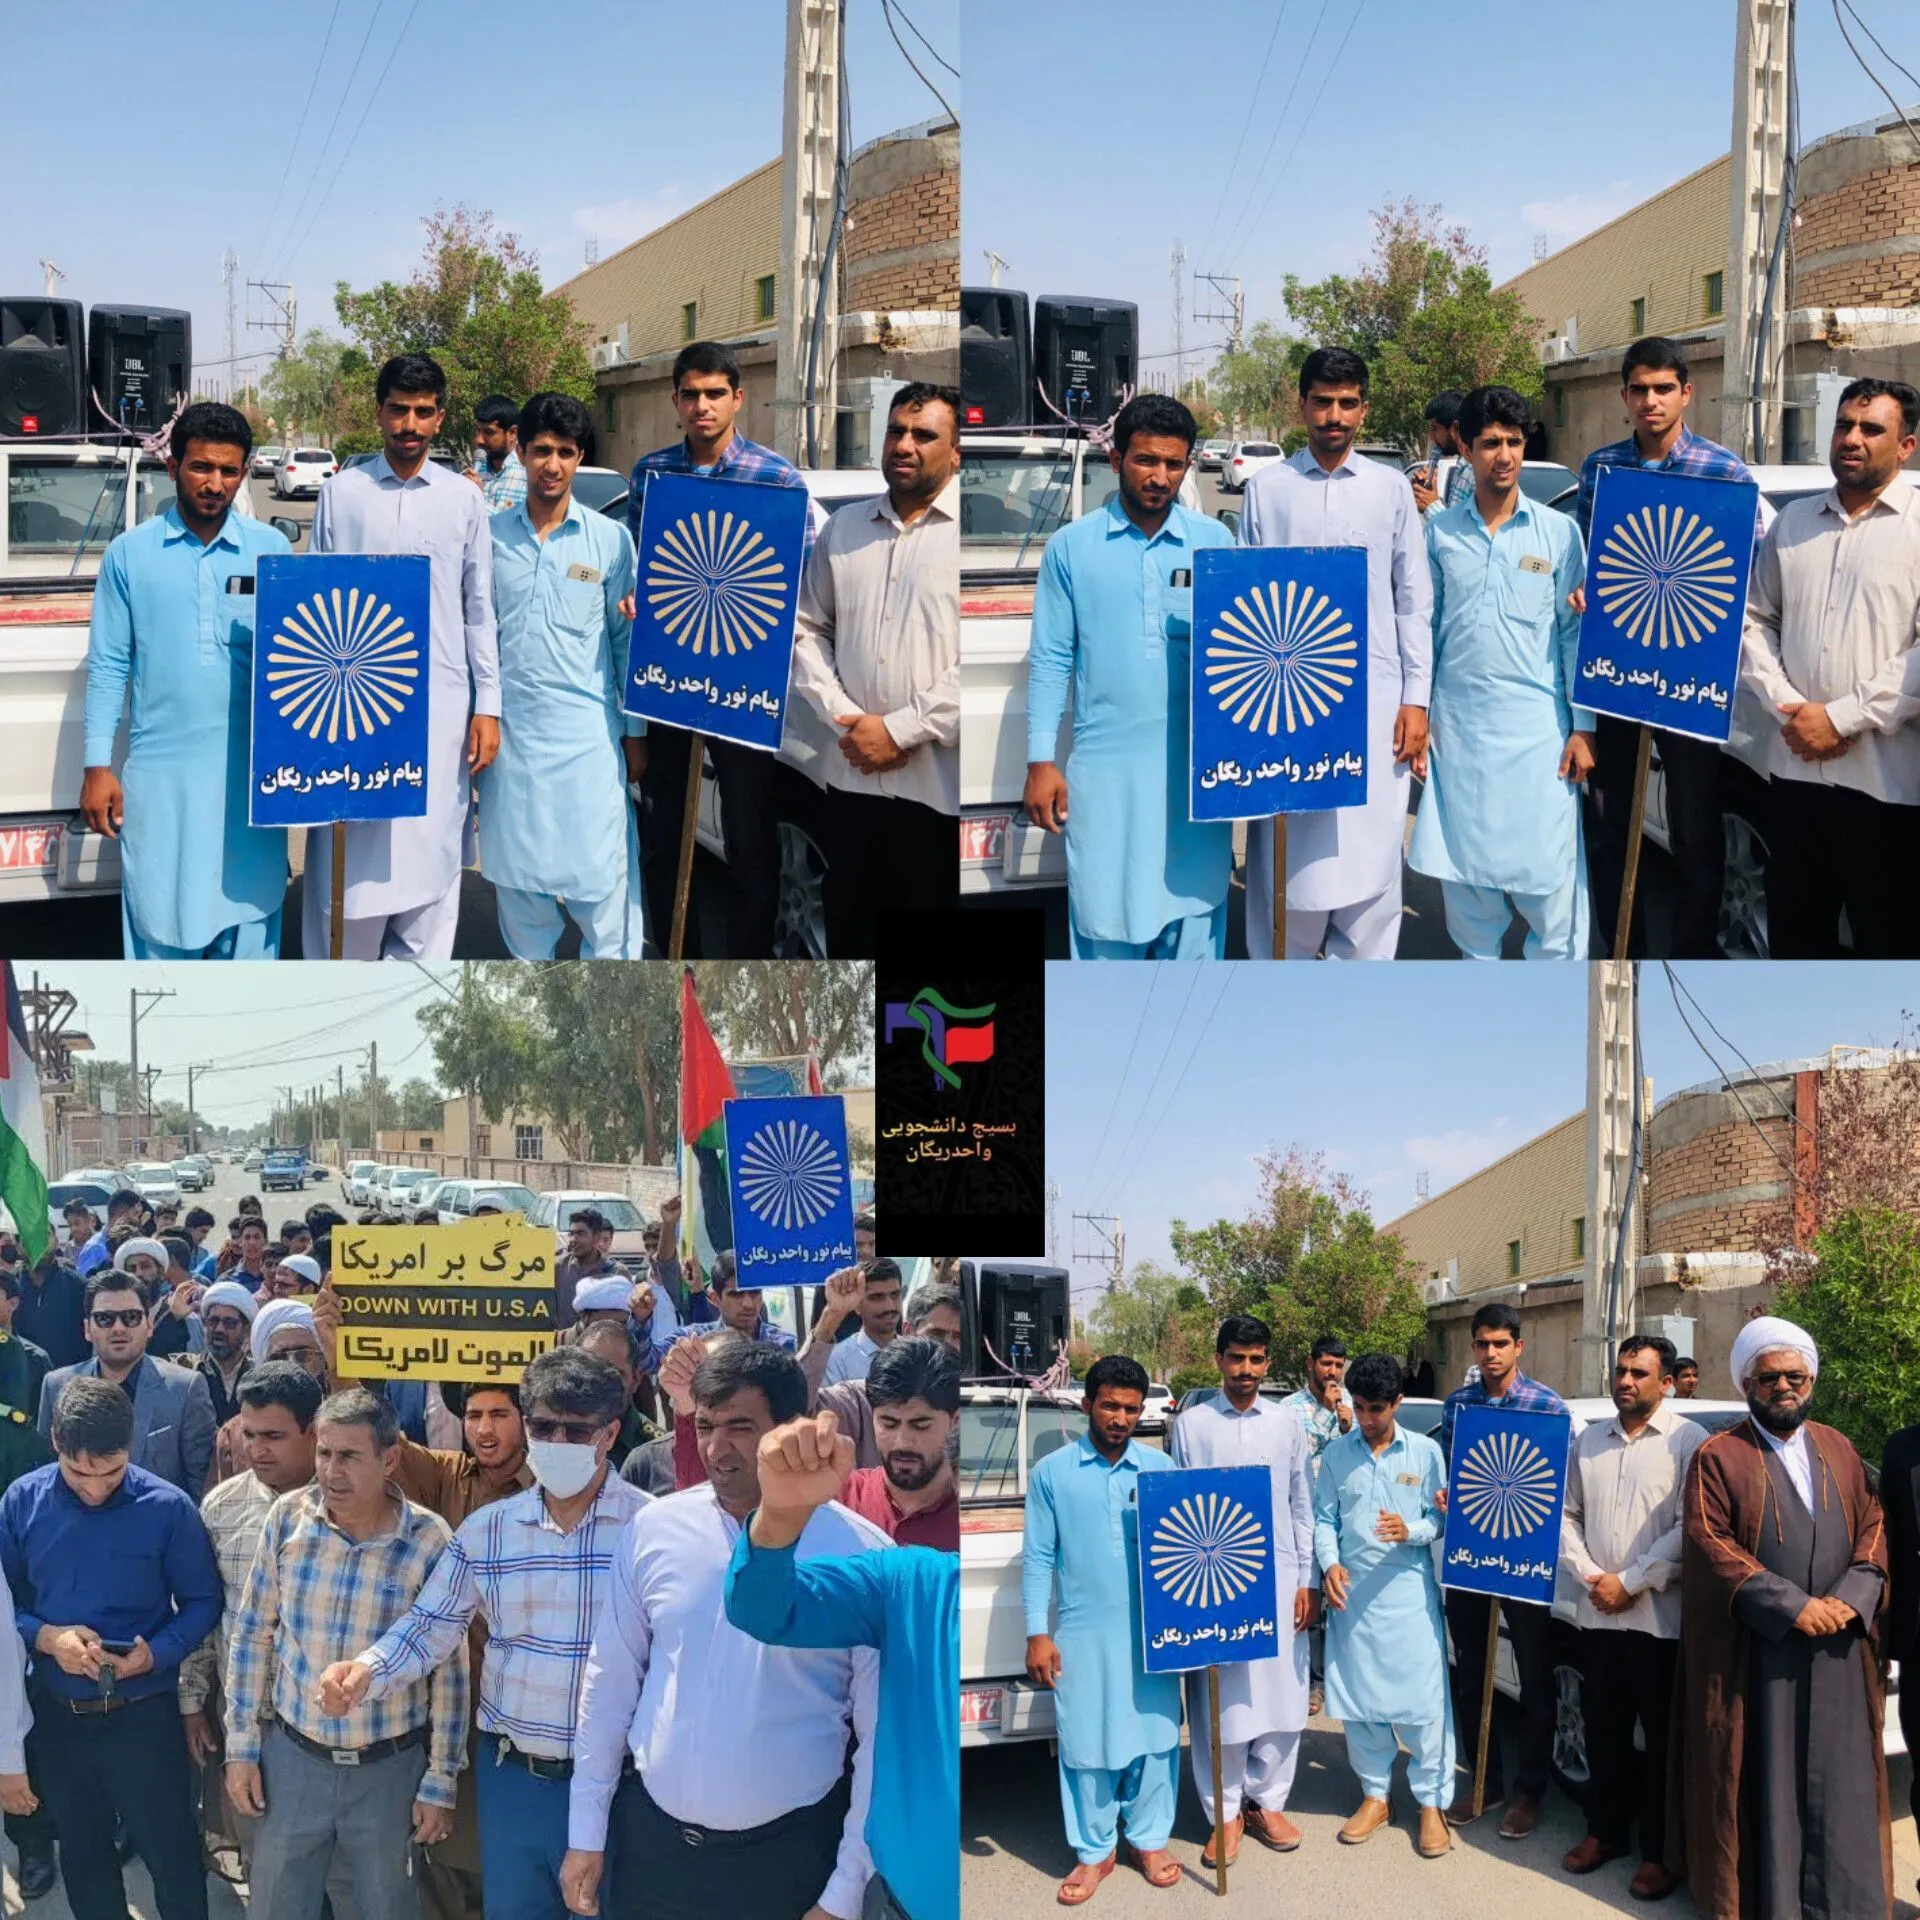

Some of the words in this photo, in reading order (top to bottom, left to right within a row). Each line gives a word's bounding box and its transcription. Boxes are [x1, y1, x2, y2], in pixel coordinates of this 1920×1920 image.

[125, 358, 144, 371] JBL
[633, 664, 675, 693] ریگان
[1582, 657, 1624, 686] ریگان
[1627, 669, 1667, 696] واحد
[679, 677, 718, 703] واحد
[720, 684, 747, 709] نور
[1669, 677, 1695, 700] نور
[1698, 682, 1727, 711] پیام
[749, 690, 779, 718] پیام
[315, 763, 360, 790] واحد
[363, 761, 390, 789] نور
[393, 760, 422, 787] پیام
[1200, 760, 1252, 788] ریگان
[1256, 756, 1301, 783] واحد
[1304, 752, 1330, 781] نور
[1333, 750, 1362, 778] پیام
[260, 766, 312, 794] ریگان
[340, 1239, 425, 1280] امریکا
[480, 1240, 546, 1281] مرگ
[742, 1246, 776, 1265] ریگان
[778, 1244, 809, 1262] واحد
[812, 1242, 829, 1262] نور
[831, 1241, 853, 1260] پیام
[438, 1254, 466, 1281] بر
[340, 1297, 410, 1315] DOWN
[417, 1298, 477, 1316] WITH
[486, 1299, 549, 1318] U.S.A
[344, 1336, 449, 1372] لامریکا
[1447, 1547, 1478, 1568] ریگان
[1481, 1554, 1510, 1574] واحد
[1511, 1558, 1530, 1576] نور
[1531, 1560, 1553, 1581] پیام
[1151, 1627, 1190, 1648] ریگان
[1192, 1622, 1226, 1642] واحد
[1228, 1619, 1248, 1641] نور
[1251, 1617, 1274, 1638] پیام
